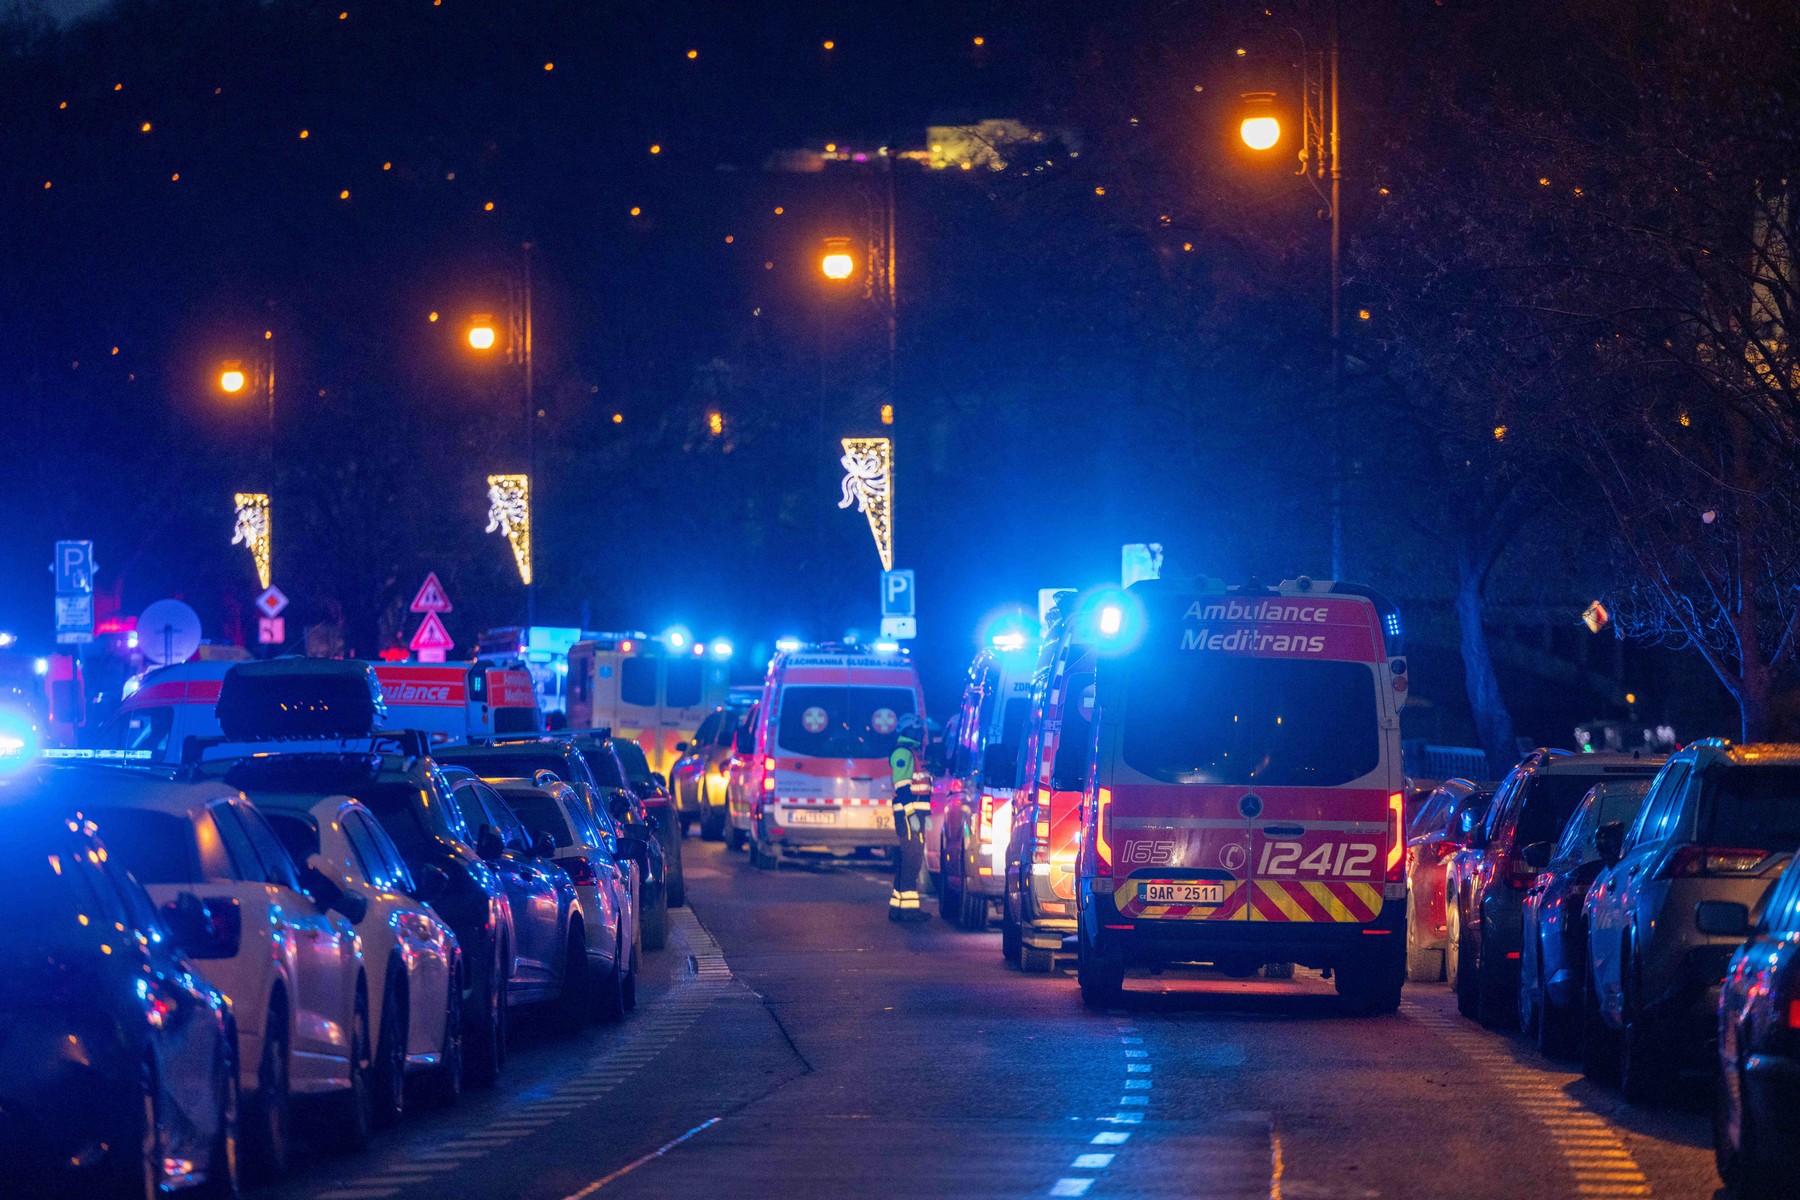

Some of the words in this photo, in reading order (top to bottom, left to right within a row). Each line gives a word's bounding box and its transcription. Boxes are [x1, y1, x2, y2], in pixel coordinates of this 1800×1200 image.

[65, 548, 84, 576] P
[889, 575, 907, 602] P
[1182, 601, 1329, 622] Ambulance
[1180, 629, 1326, 652] Meditrans
[1121, 840, 1175, 864] 165
[1256, 842, 1378, 876] 12412
[1149, 886, 1174, 900] 9AR
[1184, 887, 1217, 901] 2511
